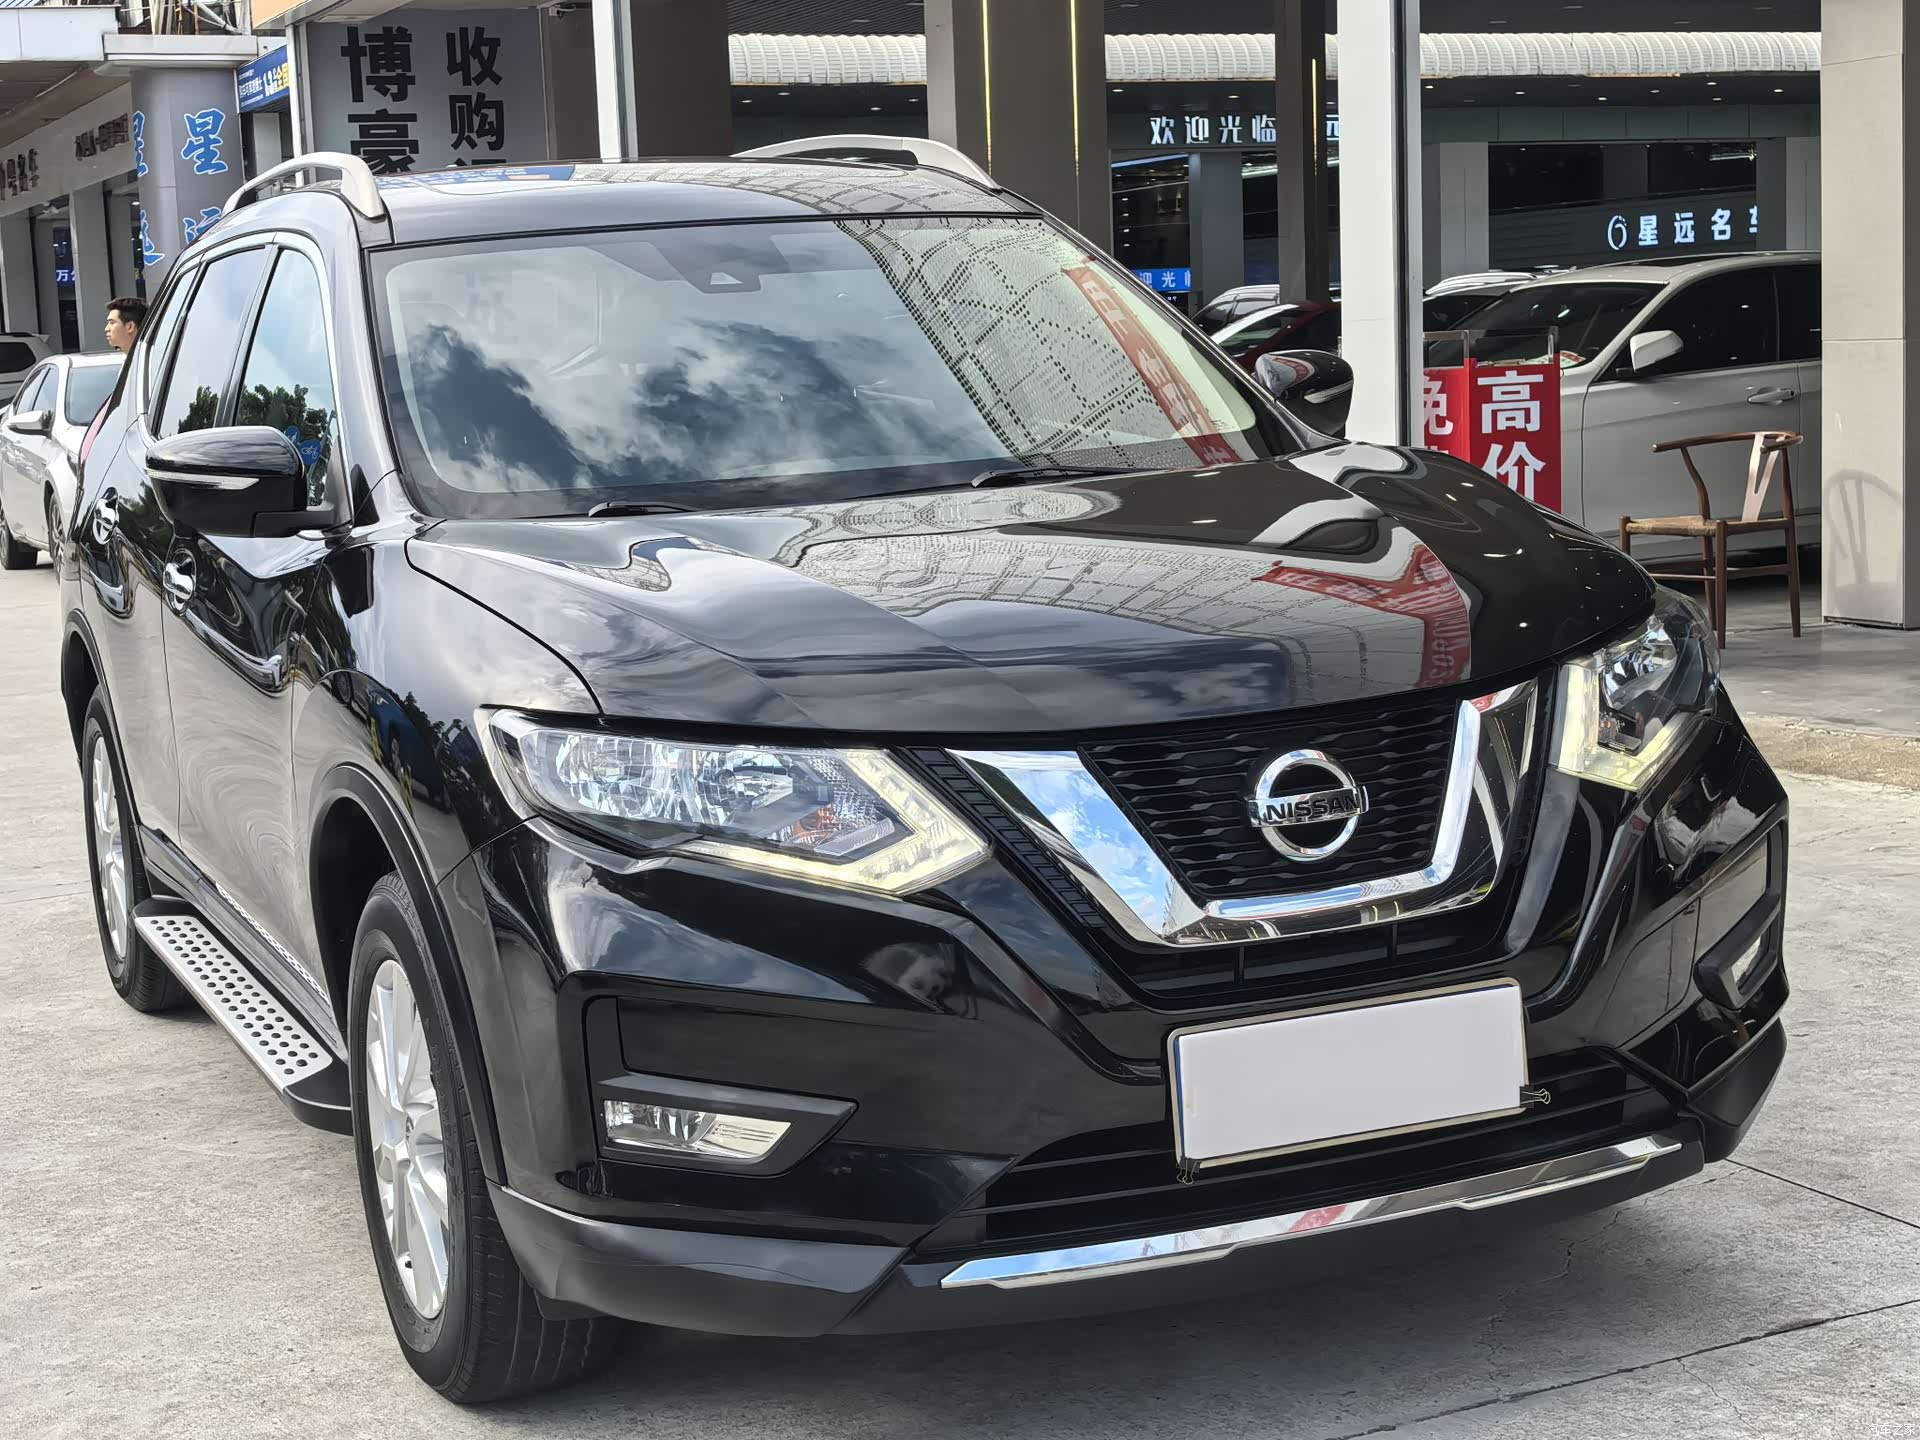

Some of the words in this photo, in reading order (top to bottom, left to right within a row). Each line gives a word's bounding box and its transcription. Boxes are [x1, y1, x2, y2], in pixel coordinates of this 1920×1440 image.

[446, 27, 506, 166] 收购
[1150, 115, 1277, 144] 欢迎光临
[1477, 370, 1547, 503] 高价
[1265, 792, 1360, 821] NISSAN
